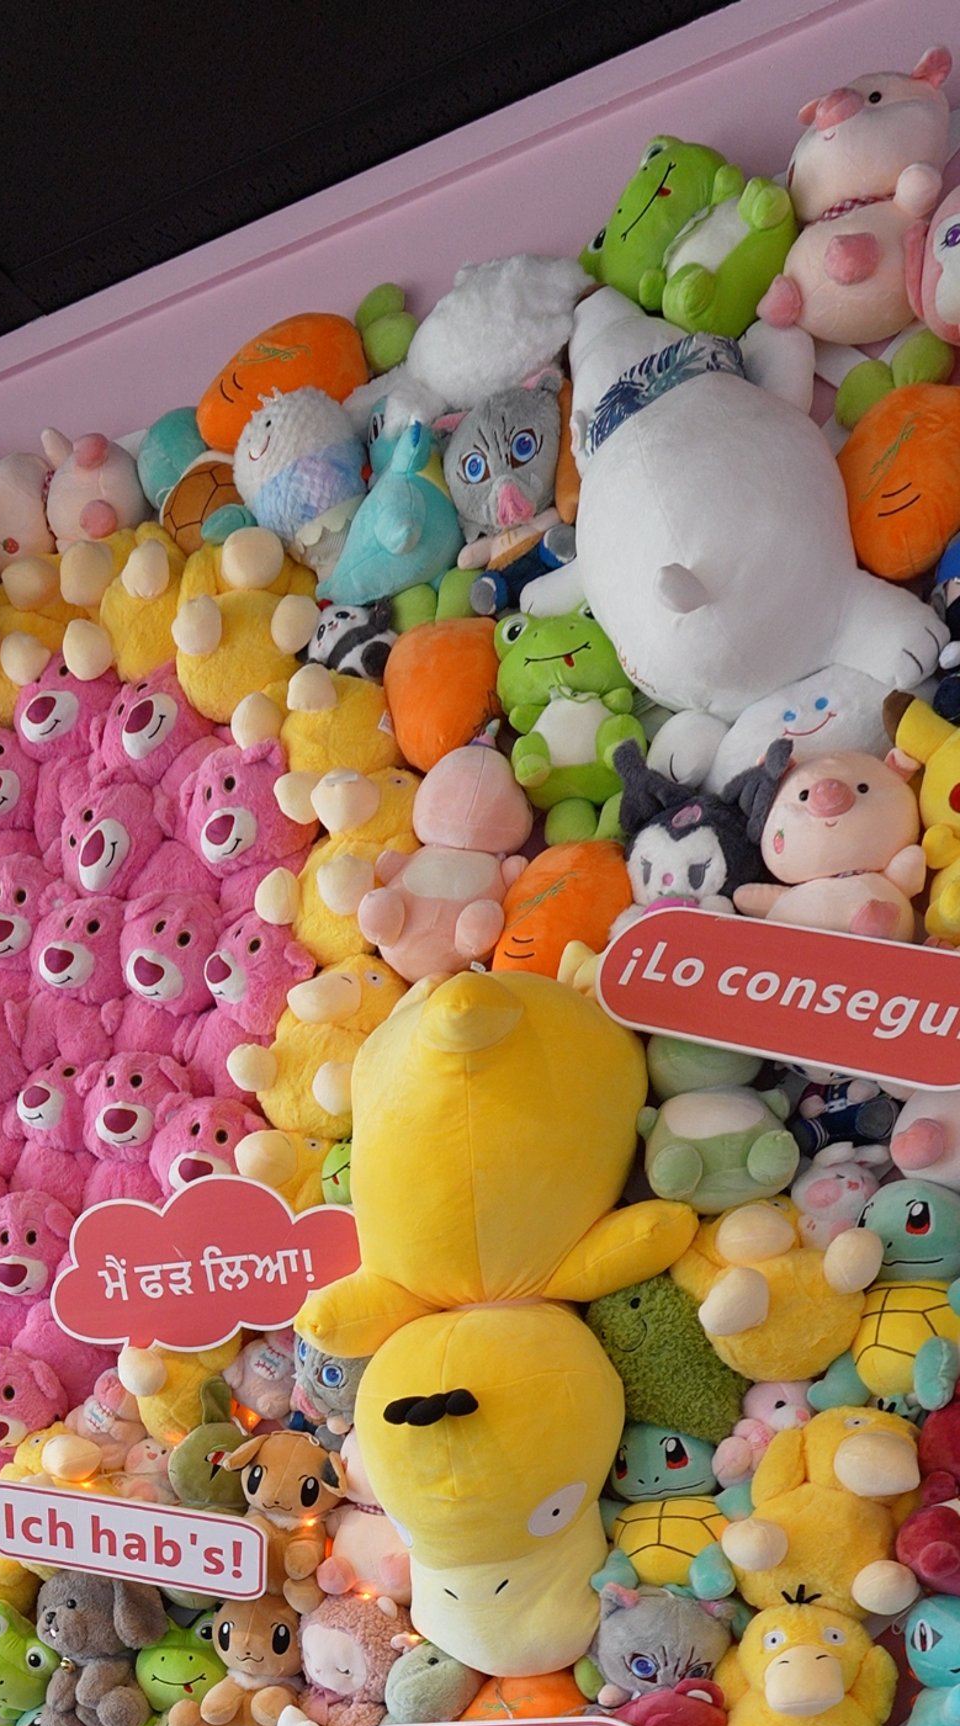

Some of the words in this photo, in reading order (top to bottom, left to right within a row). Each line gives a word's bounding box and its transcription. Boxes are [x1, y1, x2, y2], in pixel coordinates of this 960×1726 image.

[618, 941, 705, 987] ¡Lo
[716, 965, 960, 1040] consegu
[97, 1254, 129, 1301] ਮੈਂ
[134, 1261, 194, 1299] ਫੜ
[200, 1245, 315, 1292] ਲਿਆ!
[4, 1502, 74, 1550] Ich
[91, 1514, 243, 1579] hab's!
